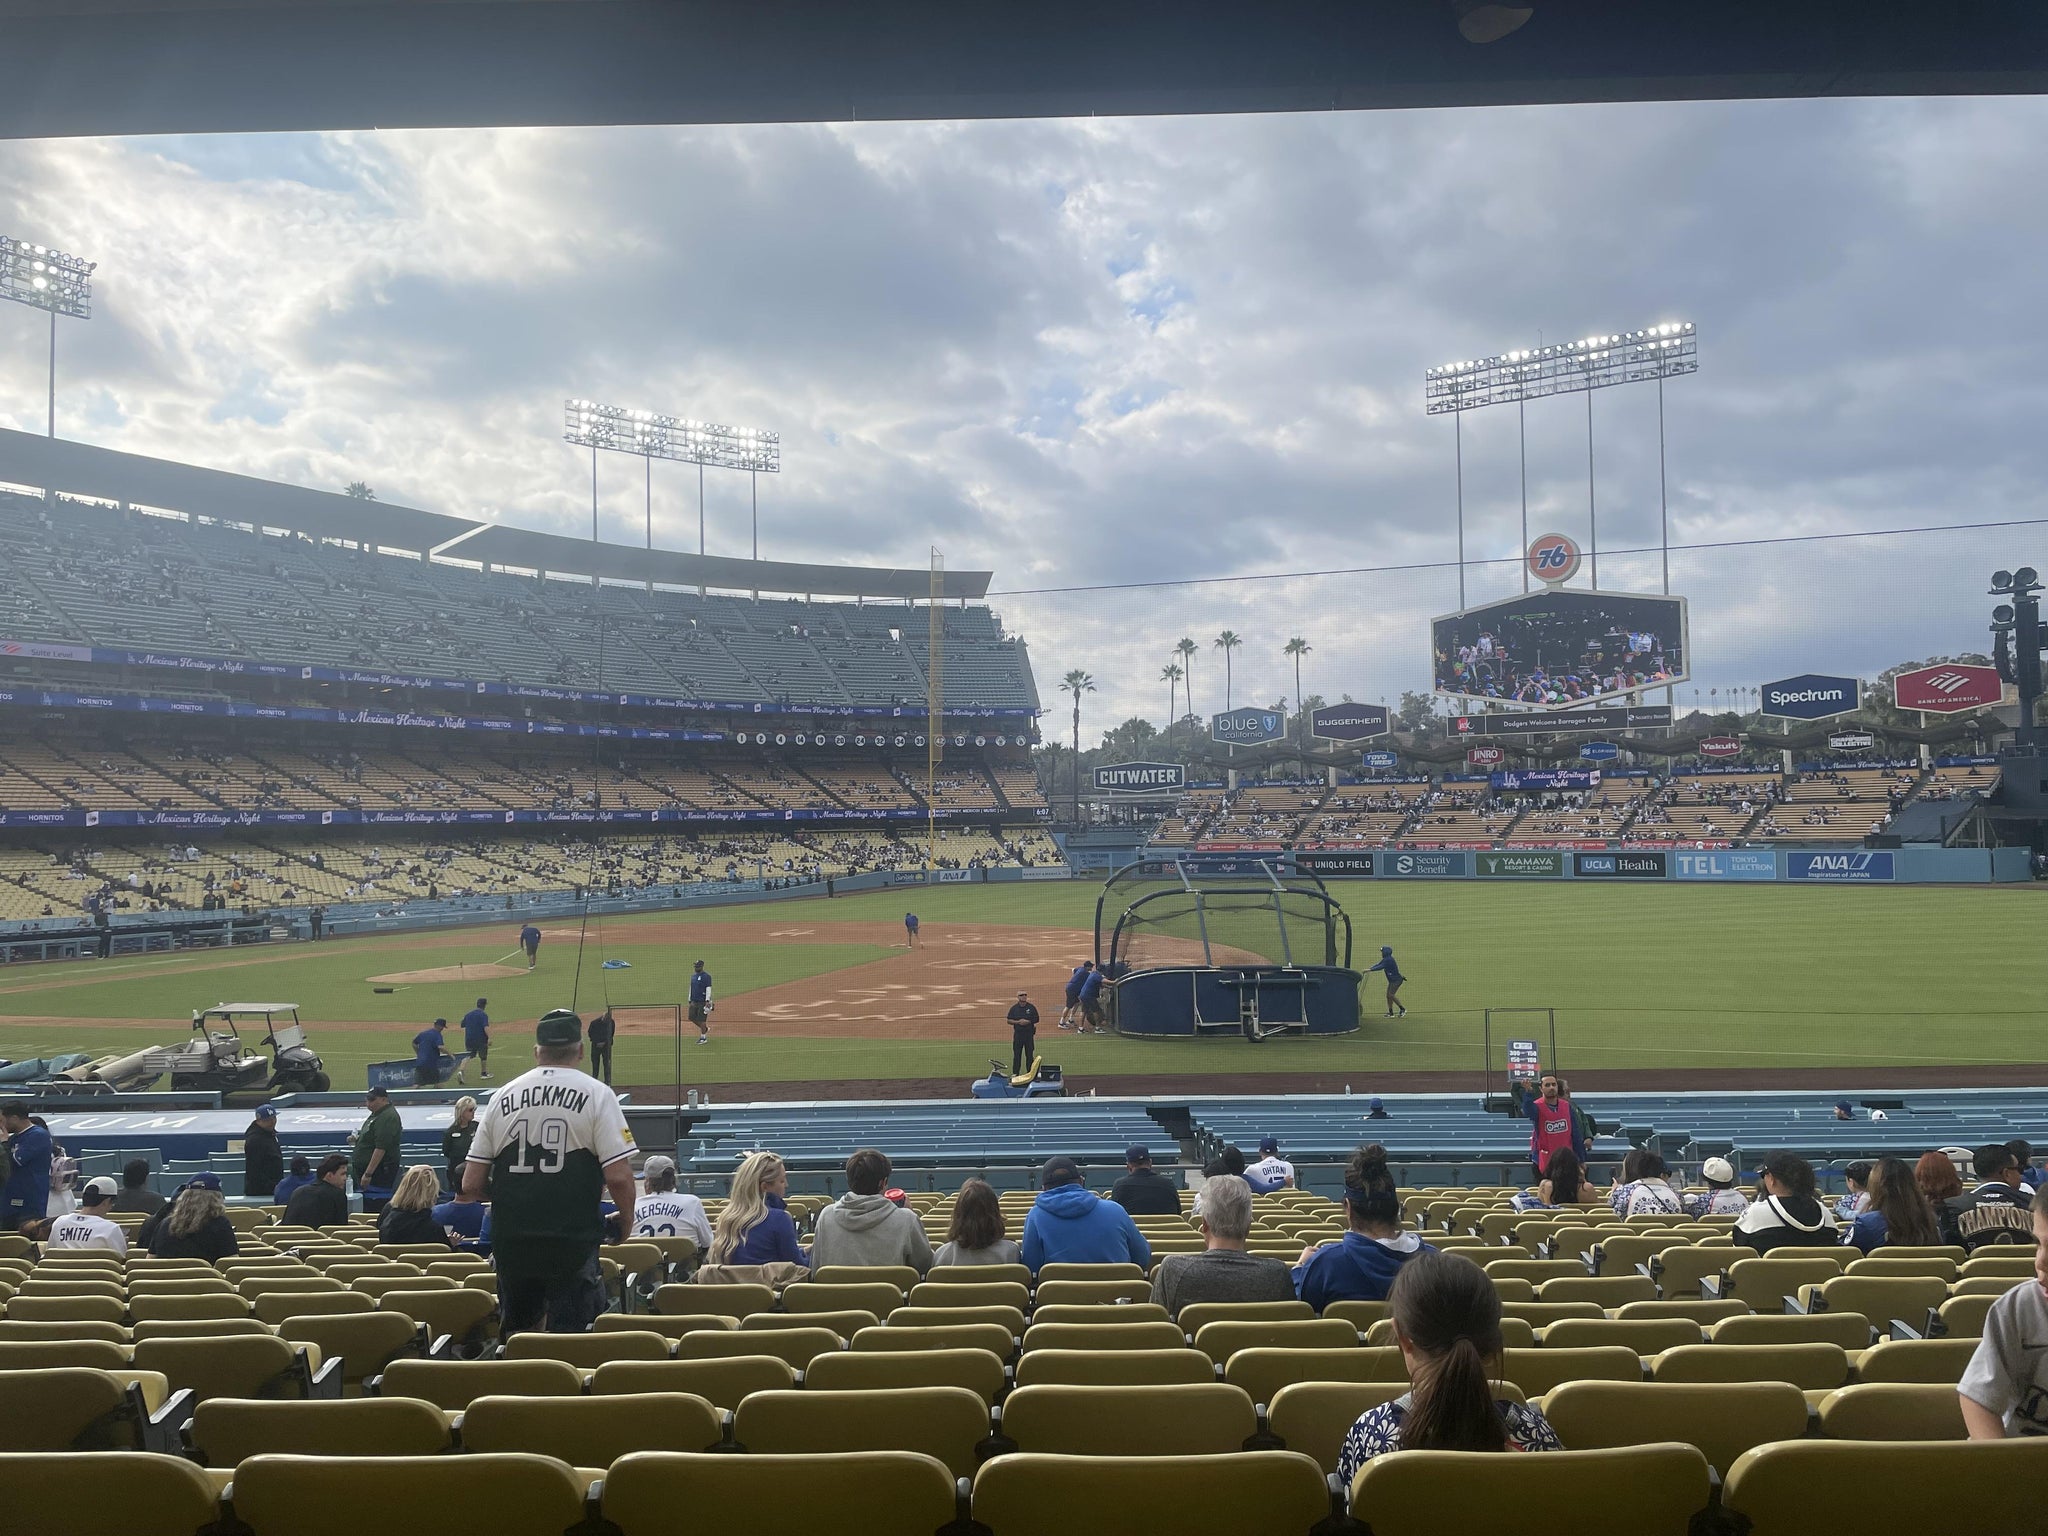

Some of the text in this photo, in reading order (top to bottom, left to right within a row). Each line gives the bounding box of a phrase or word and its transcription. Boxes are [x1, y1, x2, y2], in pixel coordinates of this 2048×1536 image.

[1535, 544, 1567, 569] 76
[31, 648, 73, 659] Suite Level
[138, 654, 244, 674] Mexican Heritage Night
[348, 672, 432, 689] Mexican Heritage Night
[77, 698, 113, 706] HORNITOS
[1771, 688, 1842, 706] Spectrum
[171, 703, 204, 711] HORNITOS
[256, 708, 286, 716] HORNITOS
[351, 710, 467, 730] Mexican Heritage Night
[1219, 715, 1258, 731] blue
[1318, 717, 1382, 726] GUGGENHEIM
[1503, 720, 1528, 728] Dodgers
[1587, 715, 1608, 724] Family
[1225, 731, 1263, 739] california
[1702, 742, 1738, 750] Yakult
[1473, 749, 1498, 761] JINRO
[1100, 769, 1177, 785] CUTWATER
[1523, 770, 1589, 780] Mexican Heritage
[1546, 779, 1568, 788] Night
[1036, 808, 1049, 816] 6:07
[28, 814, 65, 822] HORNITOS
[148, 812, 261, 826] Mexican Heritage Night
[370, 812, 458, 824] Mexican Heritage Night
[1315, 861, 1345, 870] UNIQLO
[1346, 860, 1371, 869] FIELD
[1416, 856, 1451, 866] Security
[1585, 859, 1658, 871] UCLA Health
[1679, 856, 1723, 874] TEL
[1808, 855, 1849, 870] ANA
[1218, 864, 1237, 872] Night
[1417, 865, 1447, 874] Benefit
[1732, 863, 1774, 871] ELECTRON
[942, 872, 960, 880] ANA
[1808, 871, 1840, 879] Inspiration
[500, 1085, 590, 1117] BLACKMON
[508, 1117, 569, 1174] 19
[1262, 1165, 1287, 1176] OHTANI
[634, 1202, 684, 1223] KERSHAW
[1957, 1206, 2035, 1240] CHAMPION
[59, 1227, 93, 1242] SMITH
